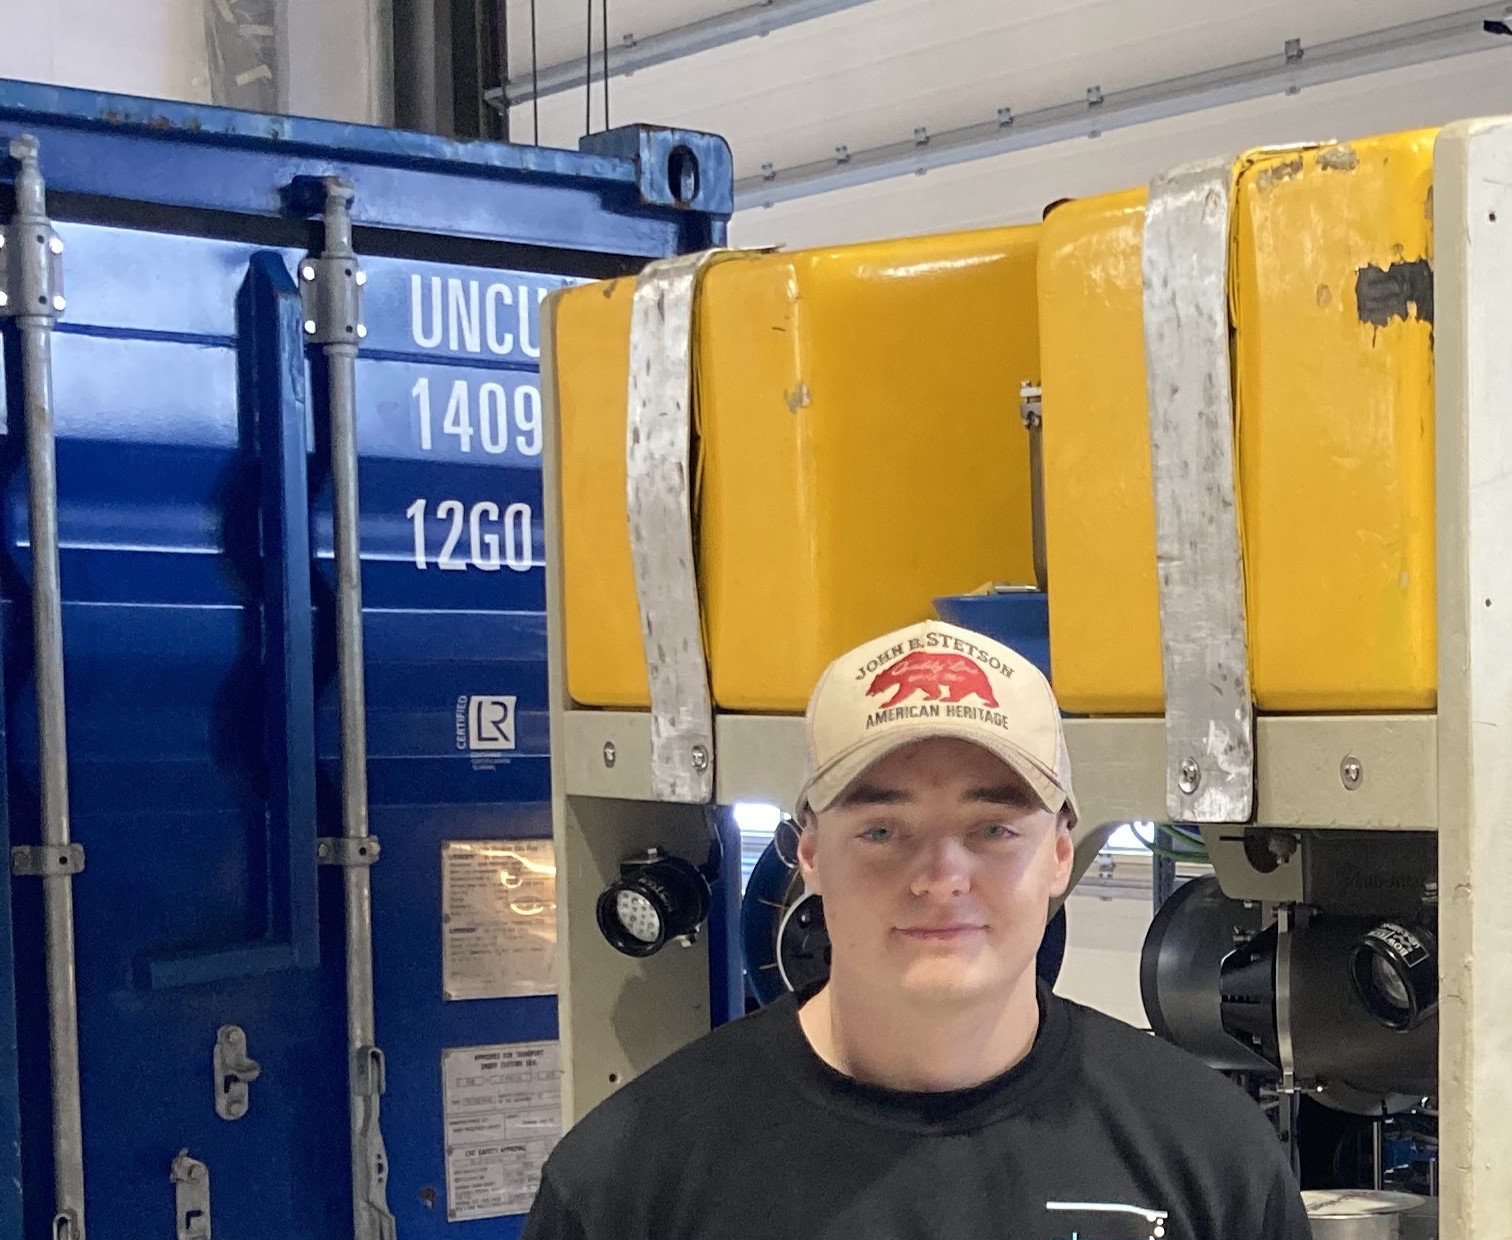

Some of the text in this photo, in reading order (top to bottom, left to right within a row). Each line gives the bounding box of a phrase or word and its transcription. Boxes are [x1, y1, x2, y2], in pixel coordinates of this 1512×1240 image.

[410, 274, 548, 358] UNCU
[411, 377, 543, 456] 1409
[855, 642, 904, 681] JOHN
[926, 632, 1015, 679] STETSON
[476, 701, 511, 742] LR
[865, 704, 1009, 731] AMERICAN HERITAGE
